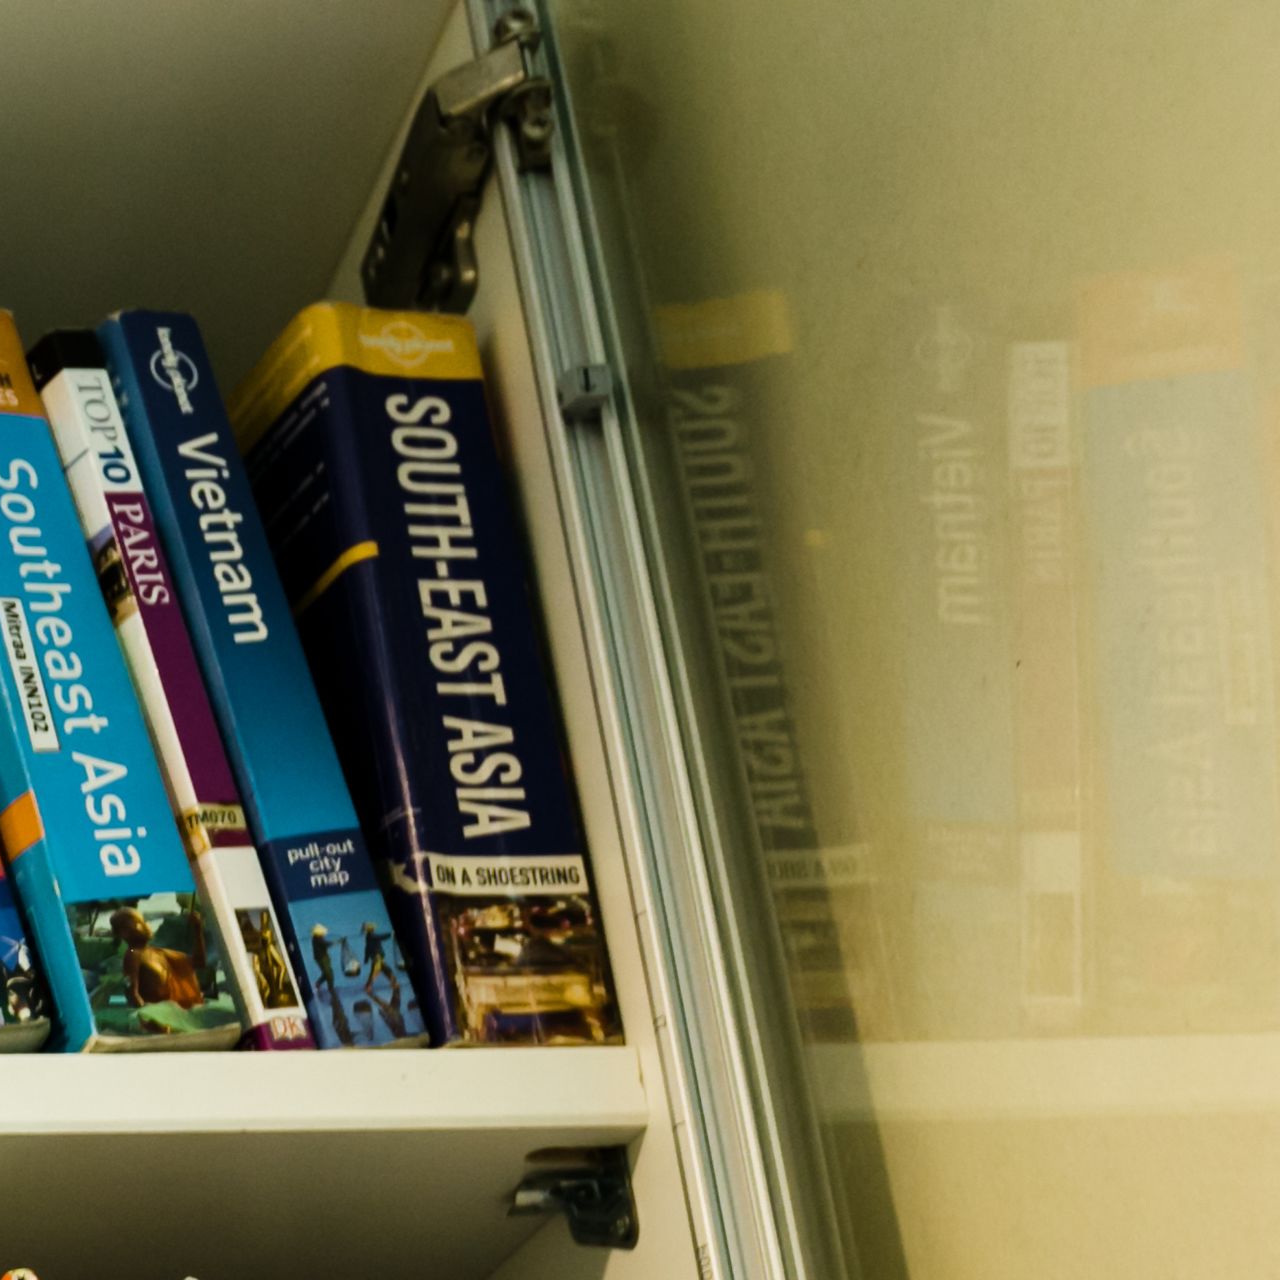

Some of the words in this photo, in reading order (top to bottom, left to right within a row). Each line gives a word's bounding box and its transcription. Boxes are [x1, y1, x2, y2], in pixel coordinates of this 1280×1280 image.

[113, 499, 170, 608] PARIS
[178, 432, 269, 646] Vietnam
[384, 393, 507, 706] SOUTH-EAST
[443, 715, 531, 840] ASIA
[286, 839, 355, 864] pull-out
[309, 853, 341, 874] city
[310, 867, 350, 889] map
[436, 864, 456, 884] ON
[460, 866, 472, 885] A
[476, 864, 580, 887] SHOESTRING
